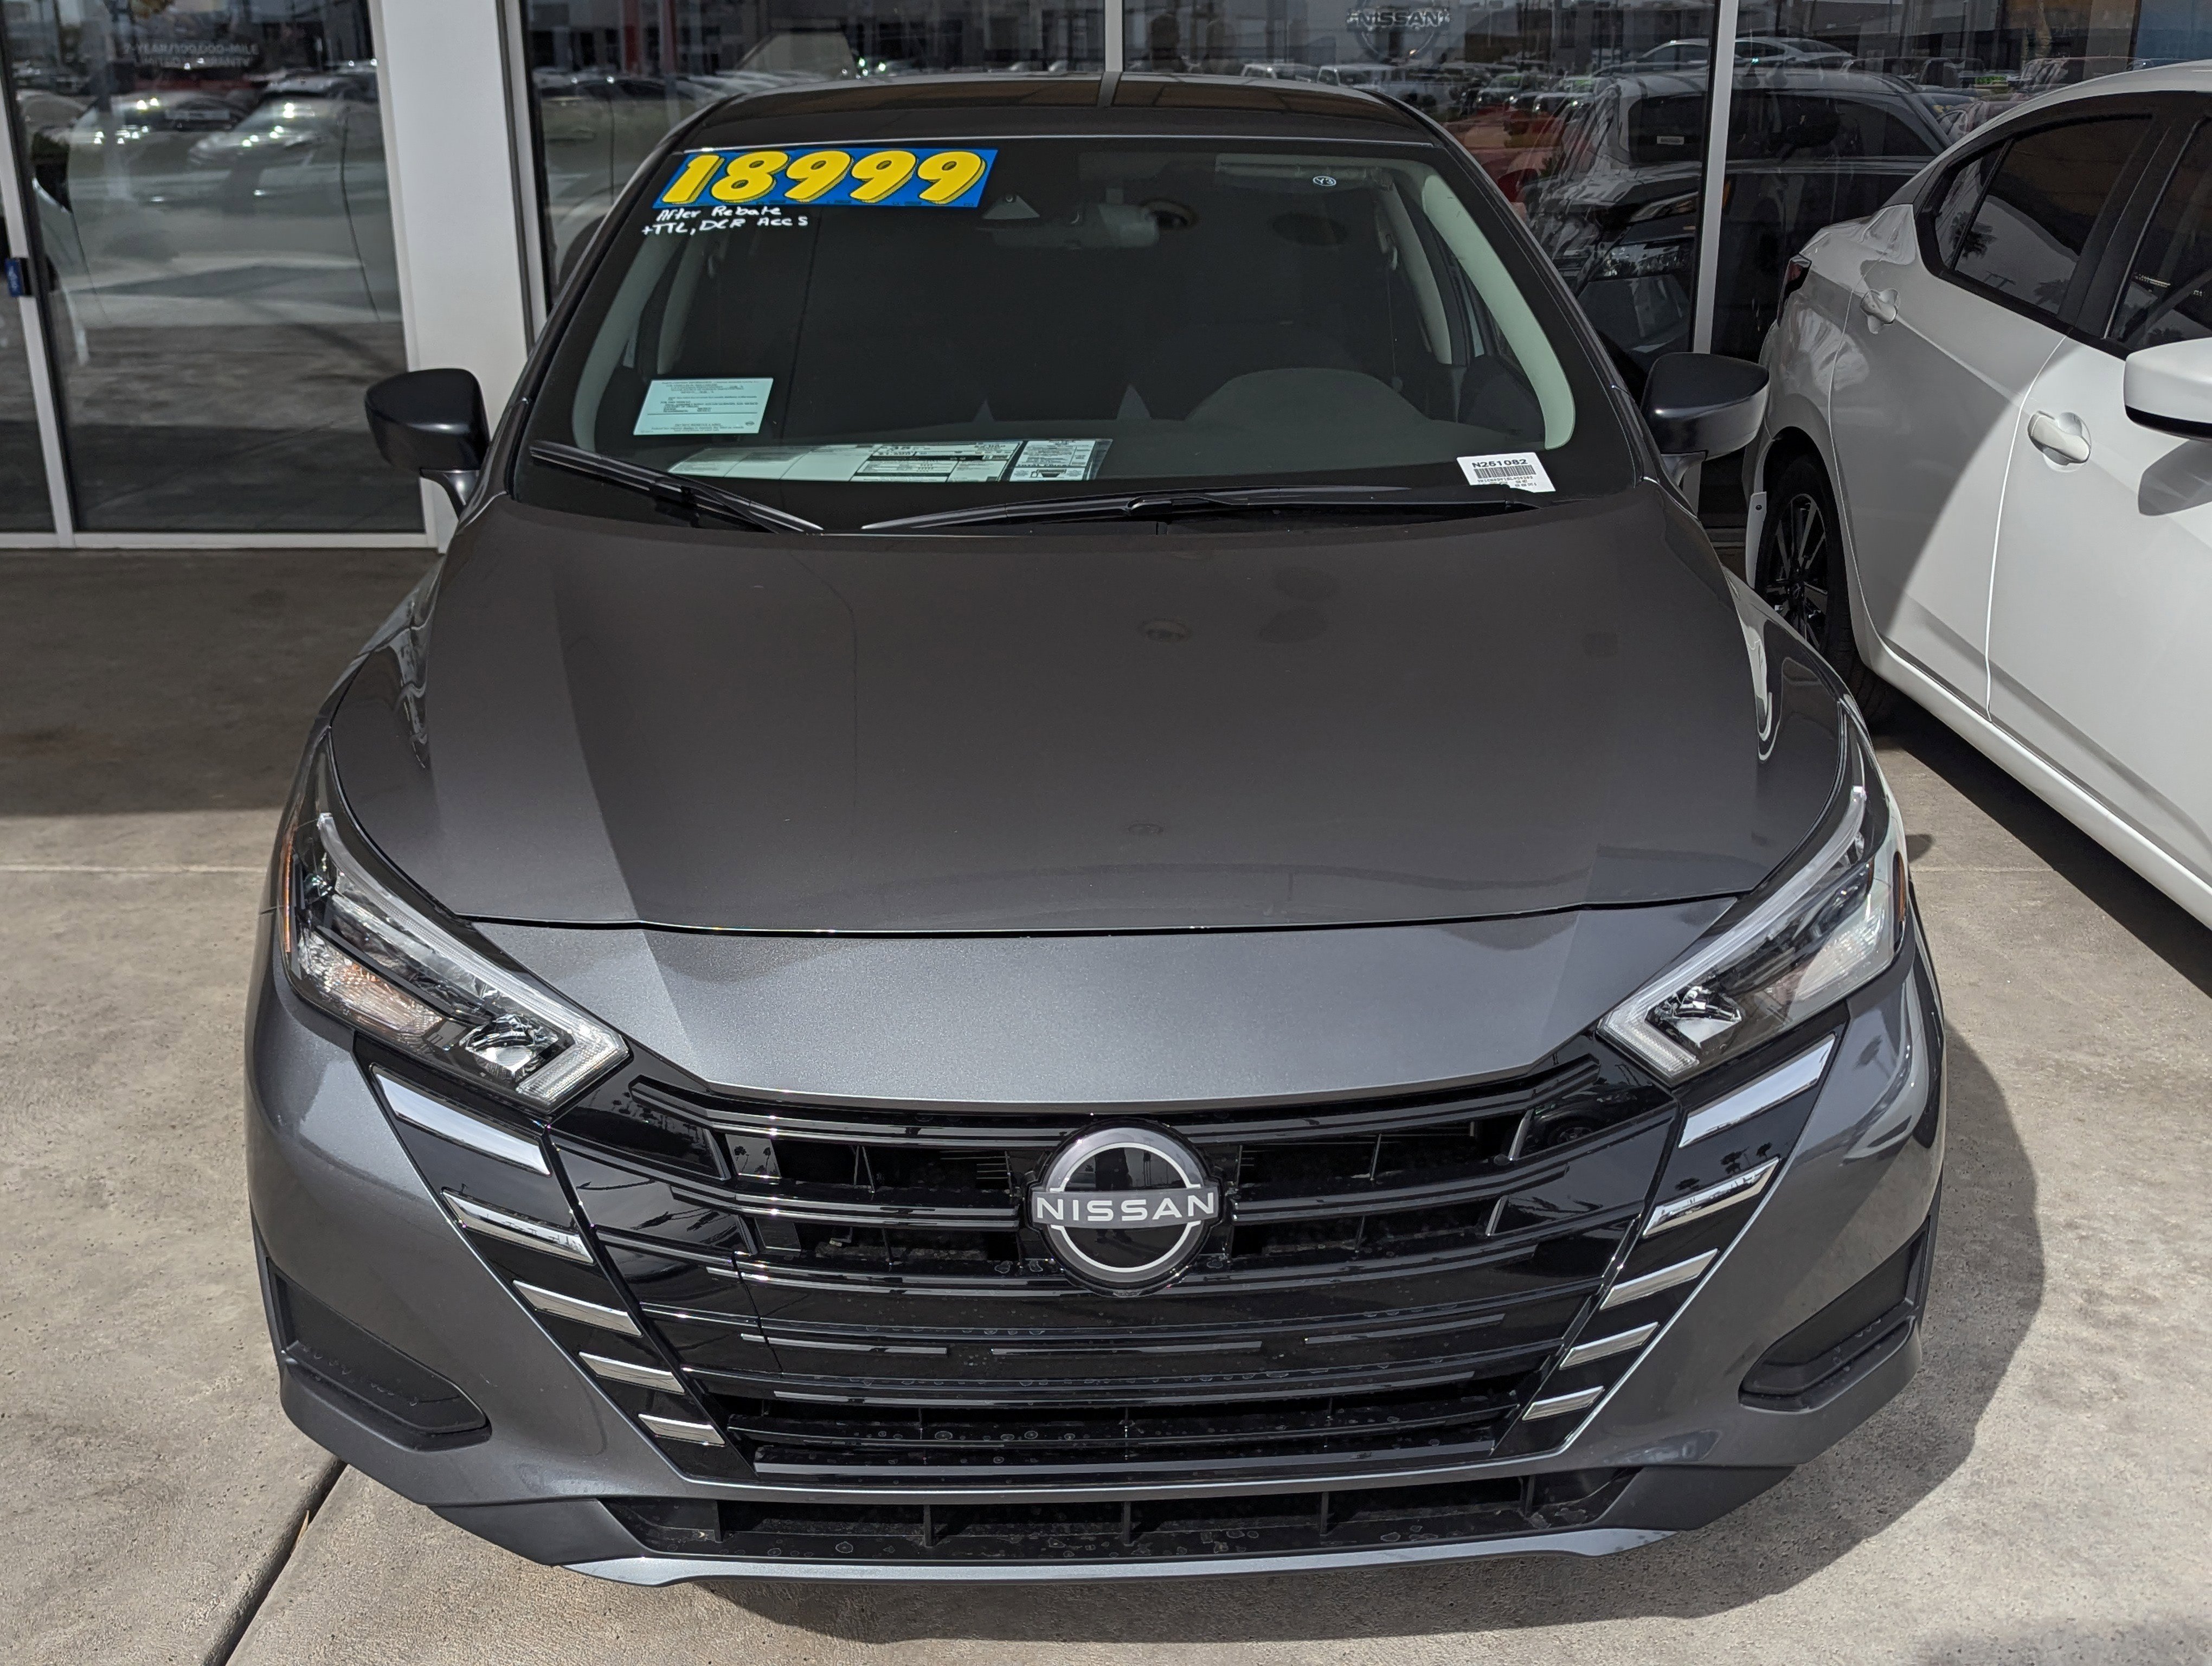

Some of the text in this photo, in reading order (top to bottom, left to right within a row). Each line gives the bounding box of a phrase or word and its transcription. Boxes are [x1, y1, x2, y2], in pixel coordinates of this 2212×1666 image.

[1357, 11, 1440, 27] NISSAN
[661, 150, 986, 204] 18999
[656, 206, 782, 221] After Rebate
[1036, 1192, 1214, 1222] NISSAN
